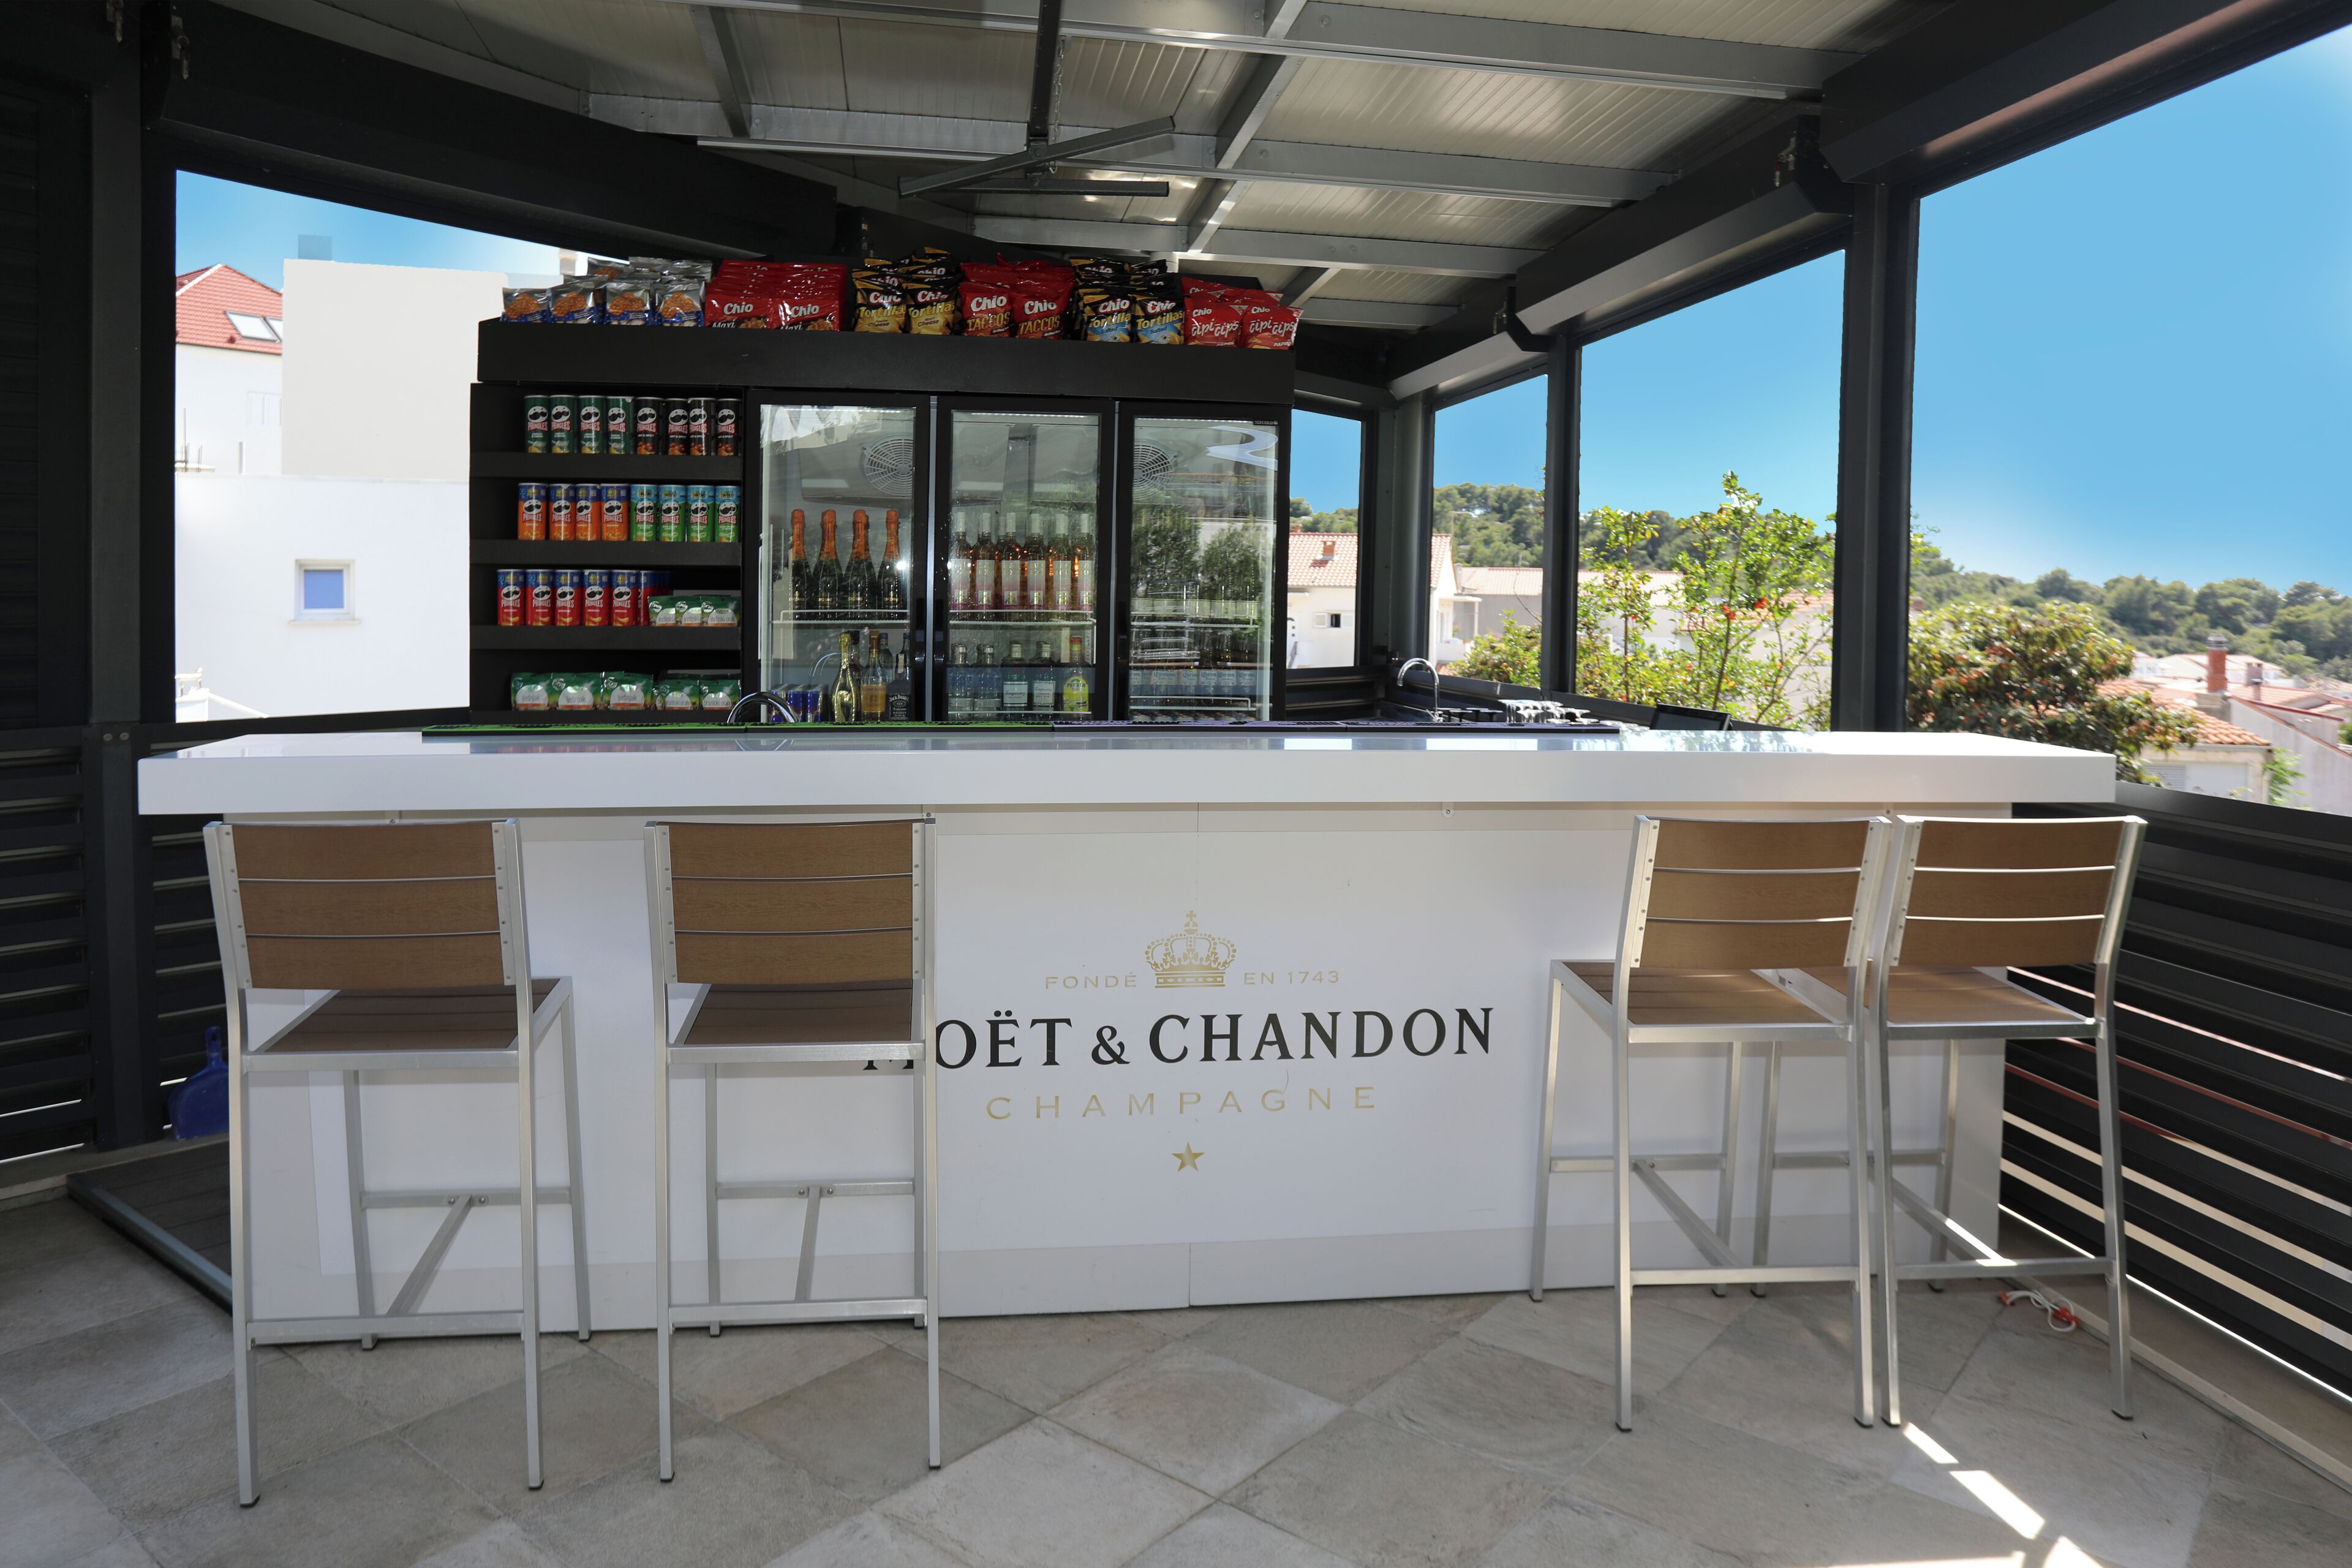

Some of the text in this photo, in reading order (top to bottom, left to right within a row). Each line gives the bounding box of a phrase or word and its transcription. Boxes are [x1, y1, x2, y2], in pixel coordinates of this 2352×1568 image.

[723, 301, 753, 315] Chio
[790, 304, 820, 318] Chio
[970, 295, 1007, 311] Chio
[1024, 300, 1057, 315] Chio
[1099, 298, 1130, 313] Chio
[1192, 307, 1212, 317] Chio
[967, 312, 1010, 332] TACCOS
[1019, 315, 1061, 334] TACCOS
[1136, 311, 1183, 330] Tortillas
[1150, 326, 1167, 334] Salted
[1045, 970, 1340, 989] FONDÉ EN 1743
[862, 1006, 1494, 1070] OËT & CHANDON
[986, 1086, 1376, 1121] CHAMPAGNE
